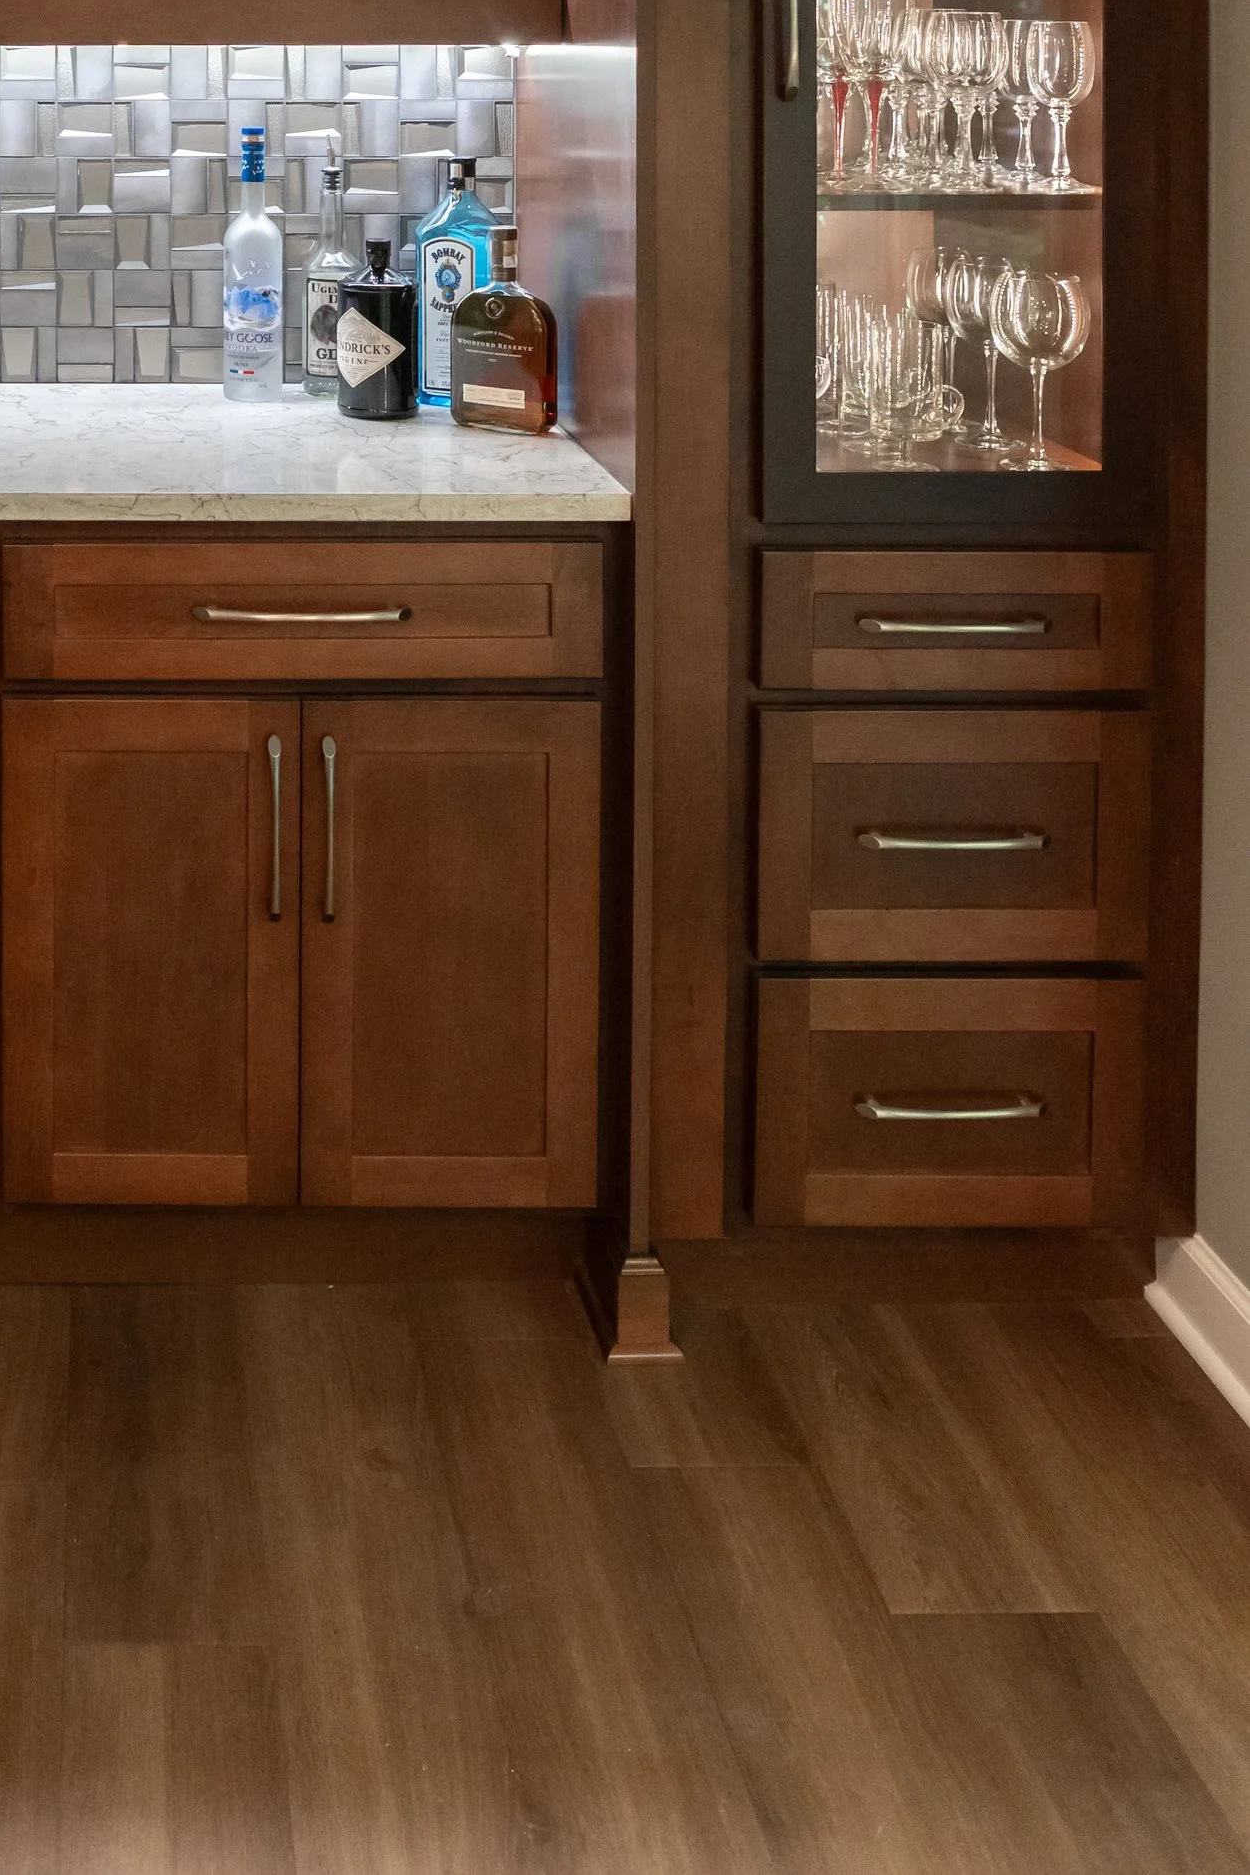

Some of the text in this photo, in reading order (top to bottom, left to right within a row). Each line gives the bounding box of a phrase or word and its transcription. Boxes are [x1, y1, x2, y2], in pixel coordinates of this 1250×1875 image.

[431, 247, 466, 264] BOMBAY
[236, 332, 273, 343] GOOSE
[227, 344, 258, 353] VODKA
[457, 337, 496, 348] WOODFORD
[497, 342, 534, 352] RESERVE
